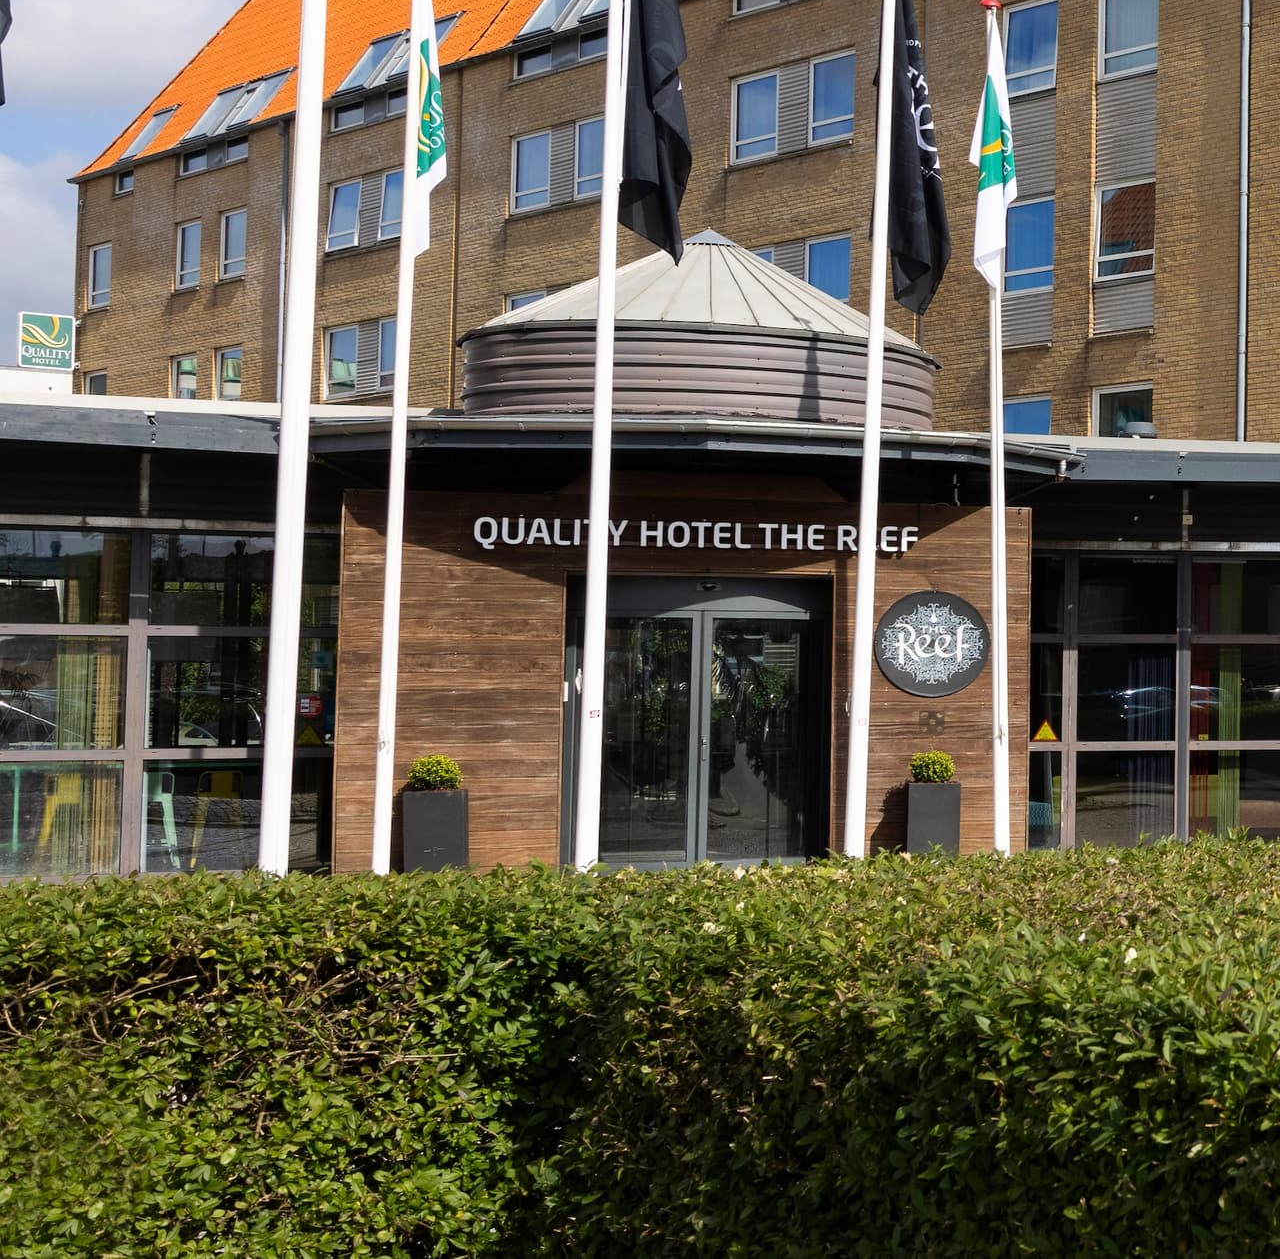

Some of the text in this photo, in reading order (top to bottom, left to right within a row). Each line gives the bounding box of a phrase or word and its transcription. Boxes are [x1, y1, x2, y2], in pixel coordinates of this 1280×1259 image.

[22, 345, 72, 360] QUALITY
[32, 357, 61, 366] HOTEL
[473, 516, 919, 552] QUALIY HOTEL THE REF
[920, 625, 947, 634] THE
[894, 623, 976, 666] Reef
